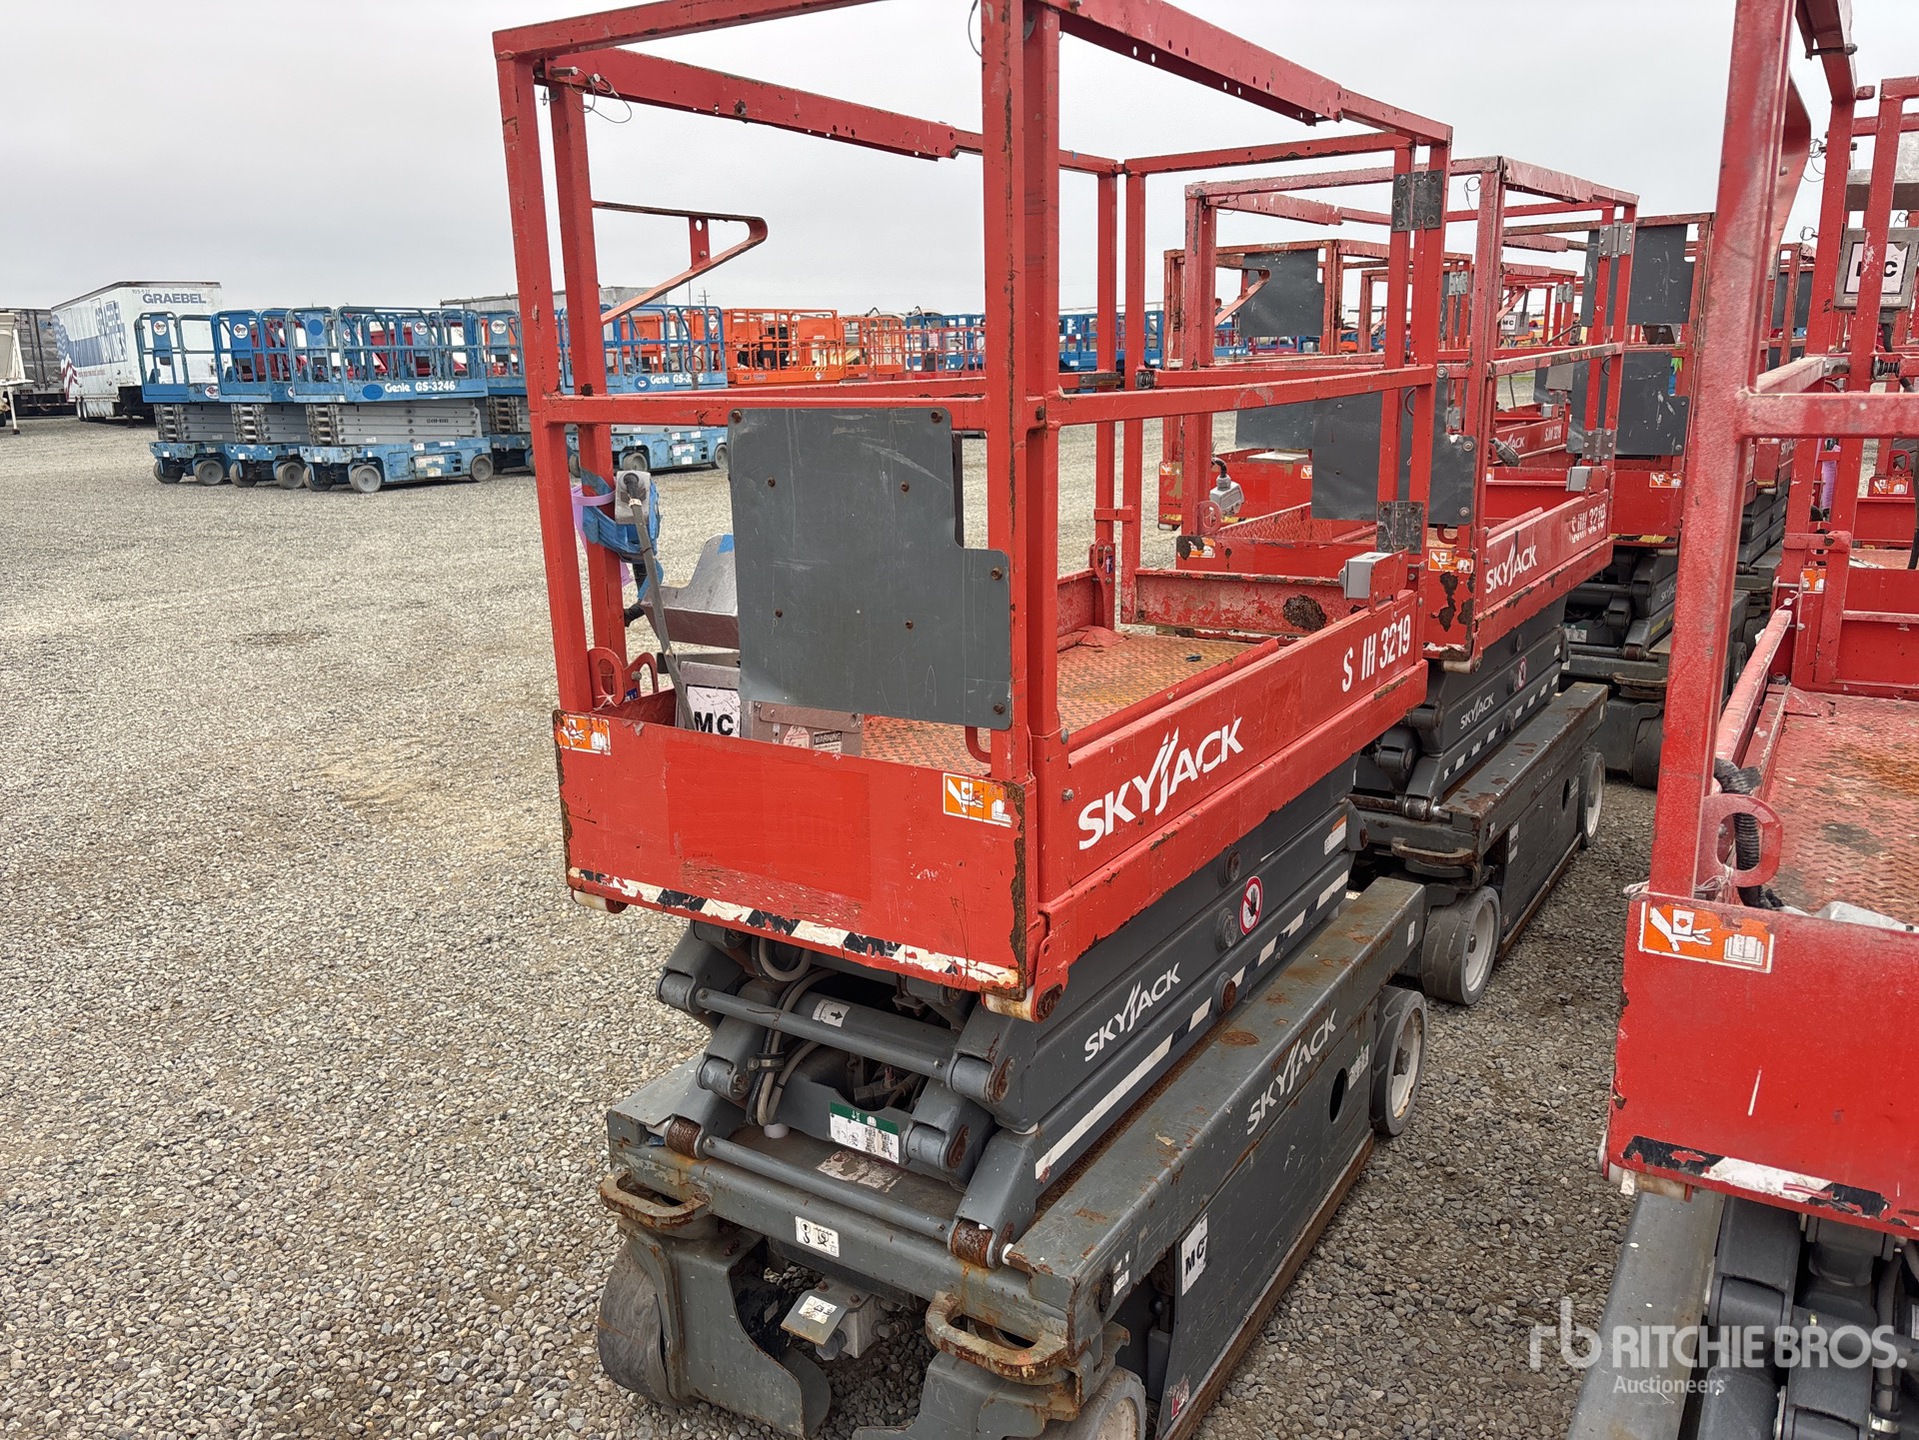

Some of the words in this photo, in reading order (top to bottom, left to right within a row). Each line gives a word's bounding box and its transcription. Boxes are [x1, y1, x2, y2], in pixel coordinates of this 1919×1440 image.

[142, 293, 207, 304] GRAEBEL
[384, 382, 411, 393] Genie
[415, 380, 456, 392] GS-3246
[1485, 542, 1538, 594] SKYJACK
[1341, 646, 1354, 693] S
[1379, 614, 1411, 669] 3219
[693, 711, 734, 736] MC
[1459, 692, 1494, 730] SKYJACK
[1078, 716, 1244, 850] SKYJACK
[1084, 962, 1181, 1062] SKYJACK
[1247, 1008, 1337, 1135] SKYJACK
[1185, 1239, 1205, 1276] MC
